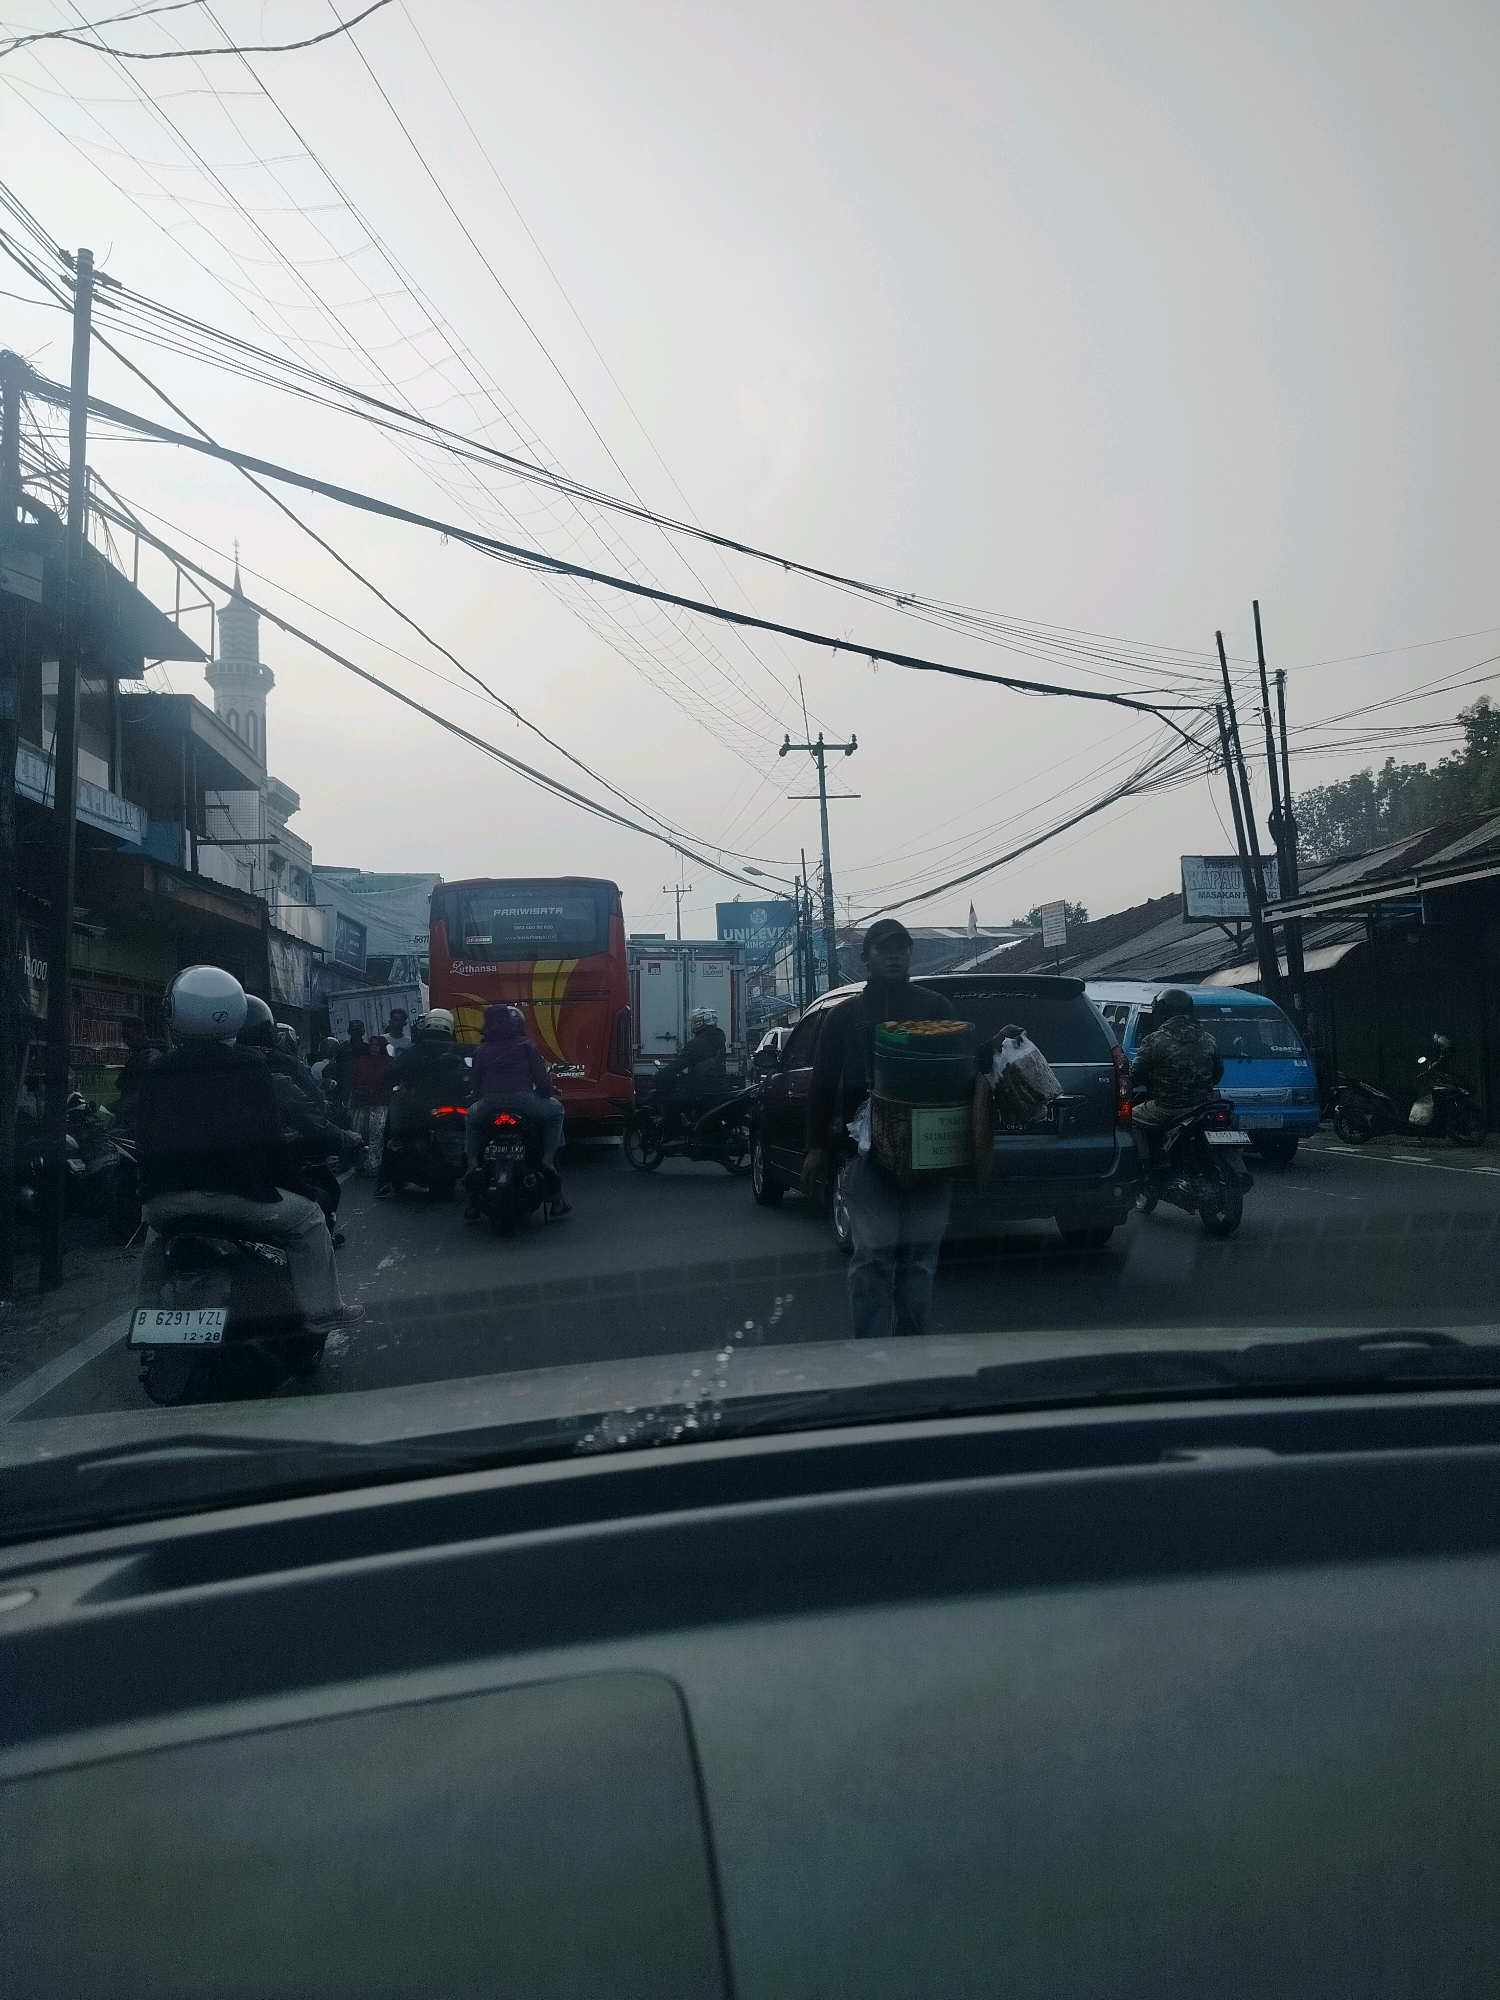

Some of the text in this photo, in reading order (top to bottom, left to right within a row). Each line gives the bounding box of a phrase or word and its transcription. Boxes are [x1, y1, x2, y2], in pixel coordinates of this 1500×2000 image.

[1198, 891, 1241, 899] MASAKAN
[494, 907, 563, 917] PARIWISATA
[450, 961, 498, 977] Luthansa
[138, 1311, 223, 1326] B 6291 VZL
